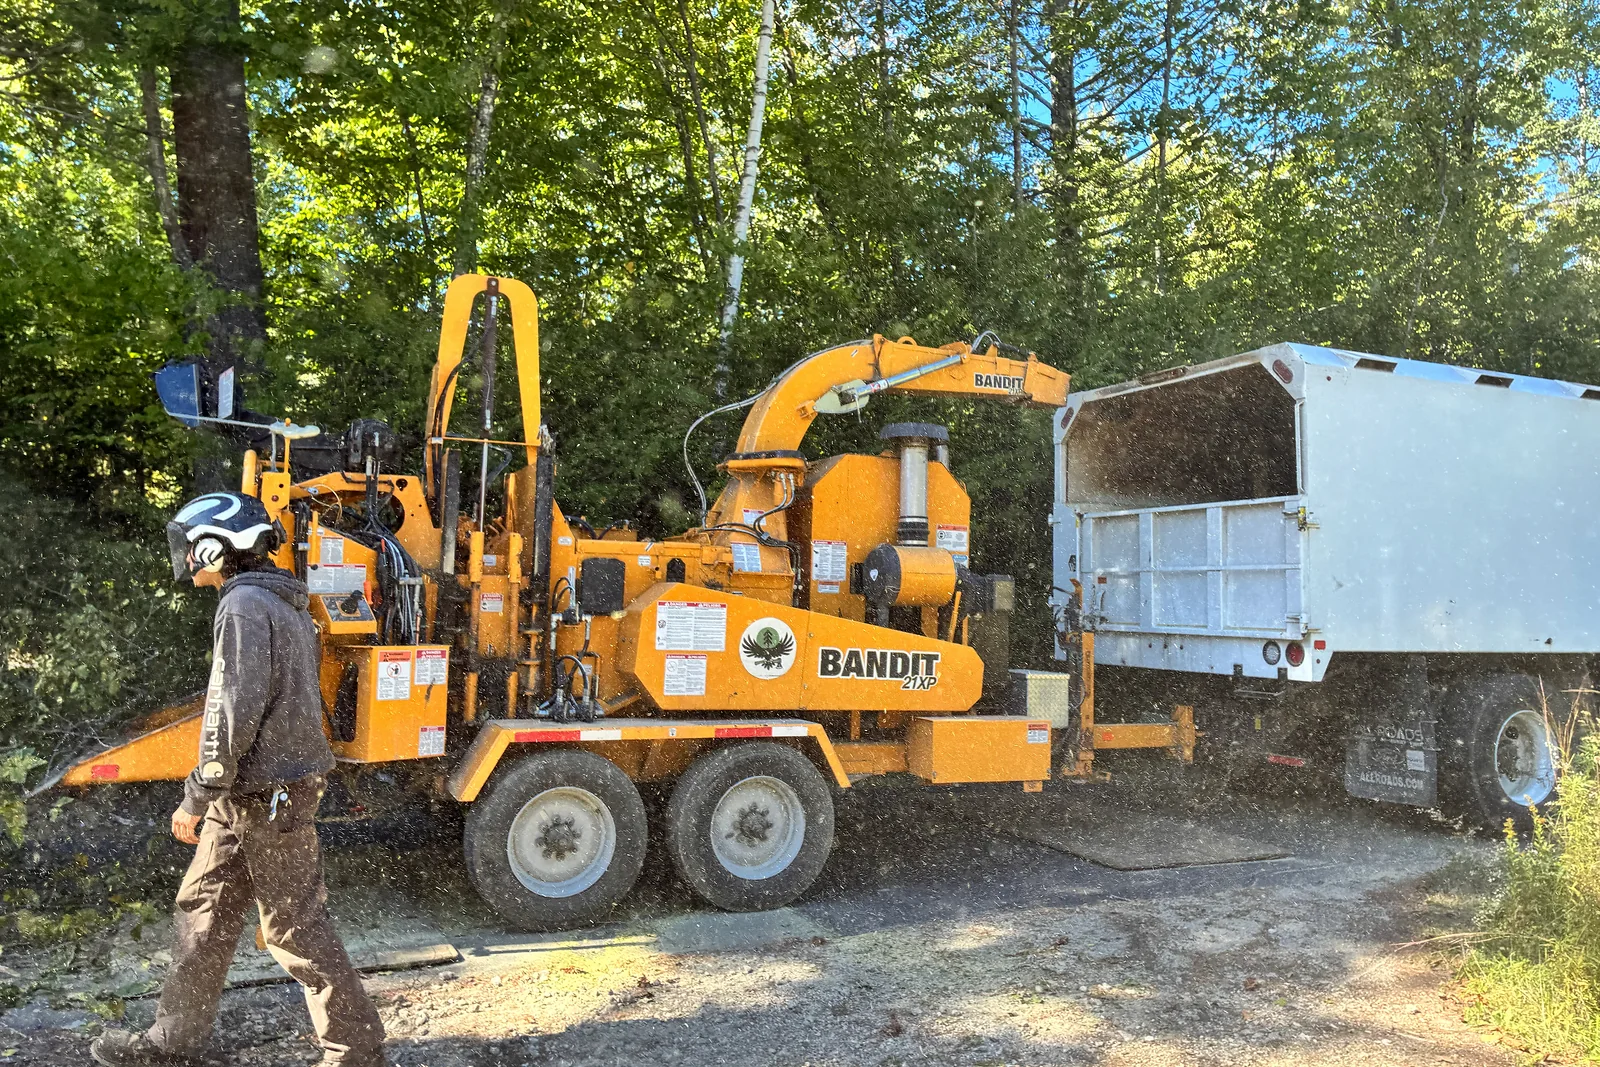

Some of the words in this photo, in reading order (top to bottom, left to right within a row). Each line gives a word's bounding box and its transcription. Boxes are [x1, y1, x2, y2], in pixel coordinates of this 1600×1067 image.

[974, 373, 1024, 389] BANDIT
[819, 648, 940, 679] BANDIT
[902, 676, 937, 690] 21XP
[204, 657, 226, 760] carhartt
